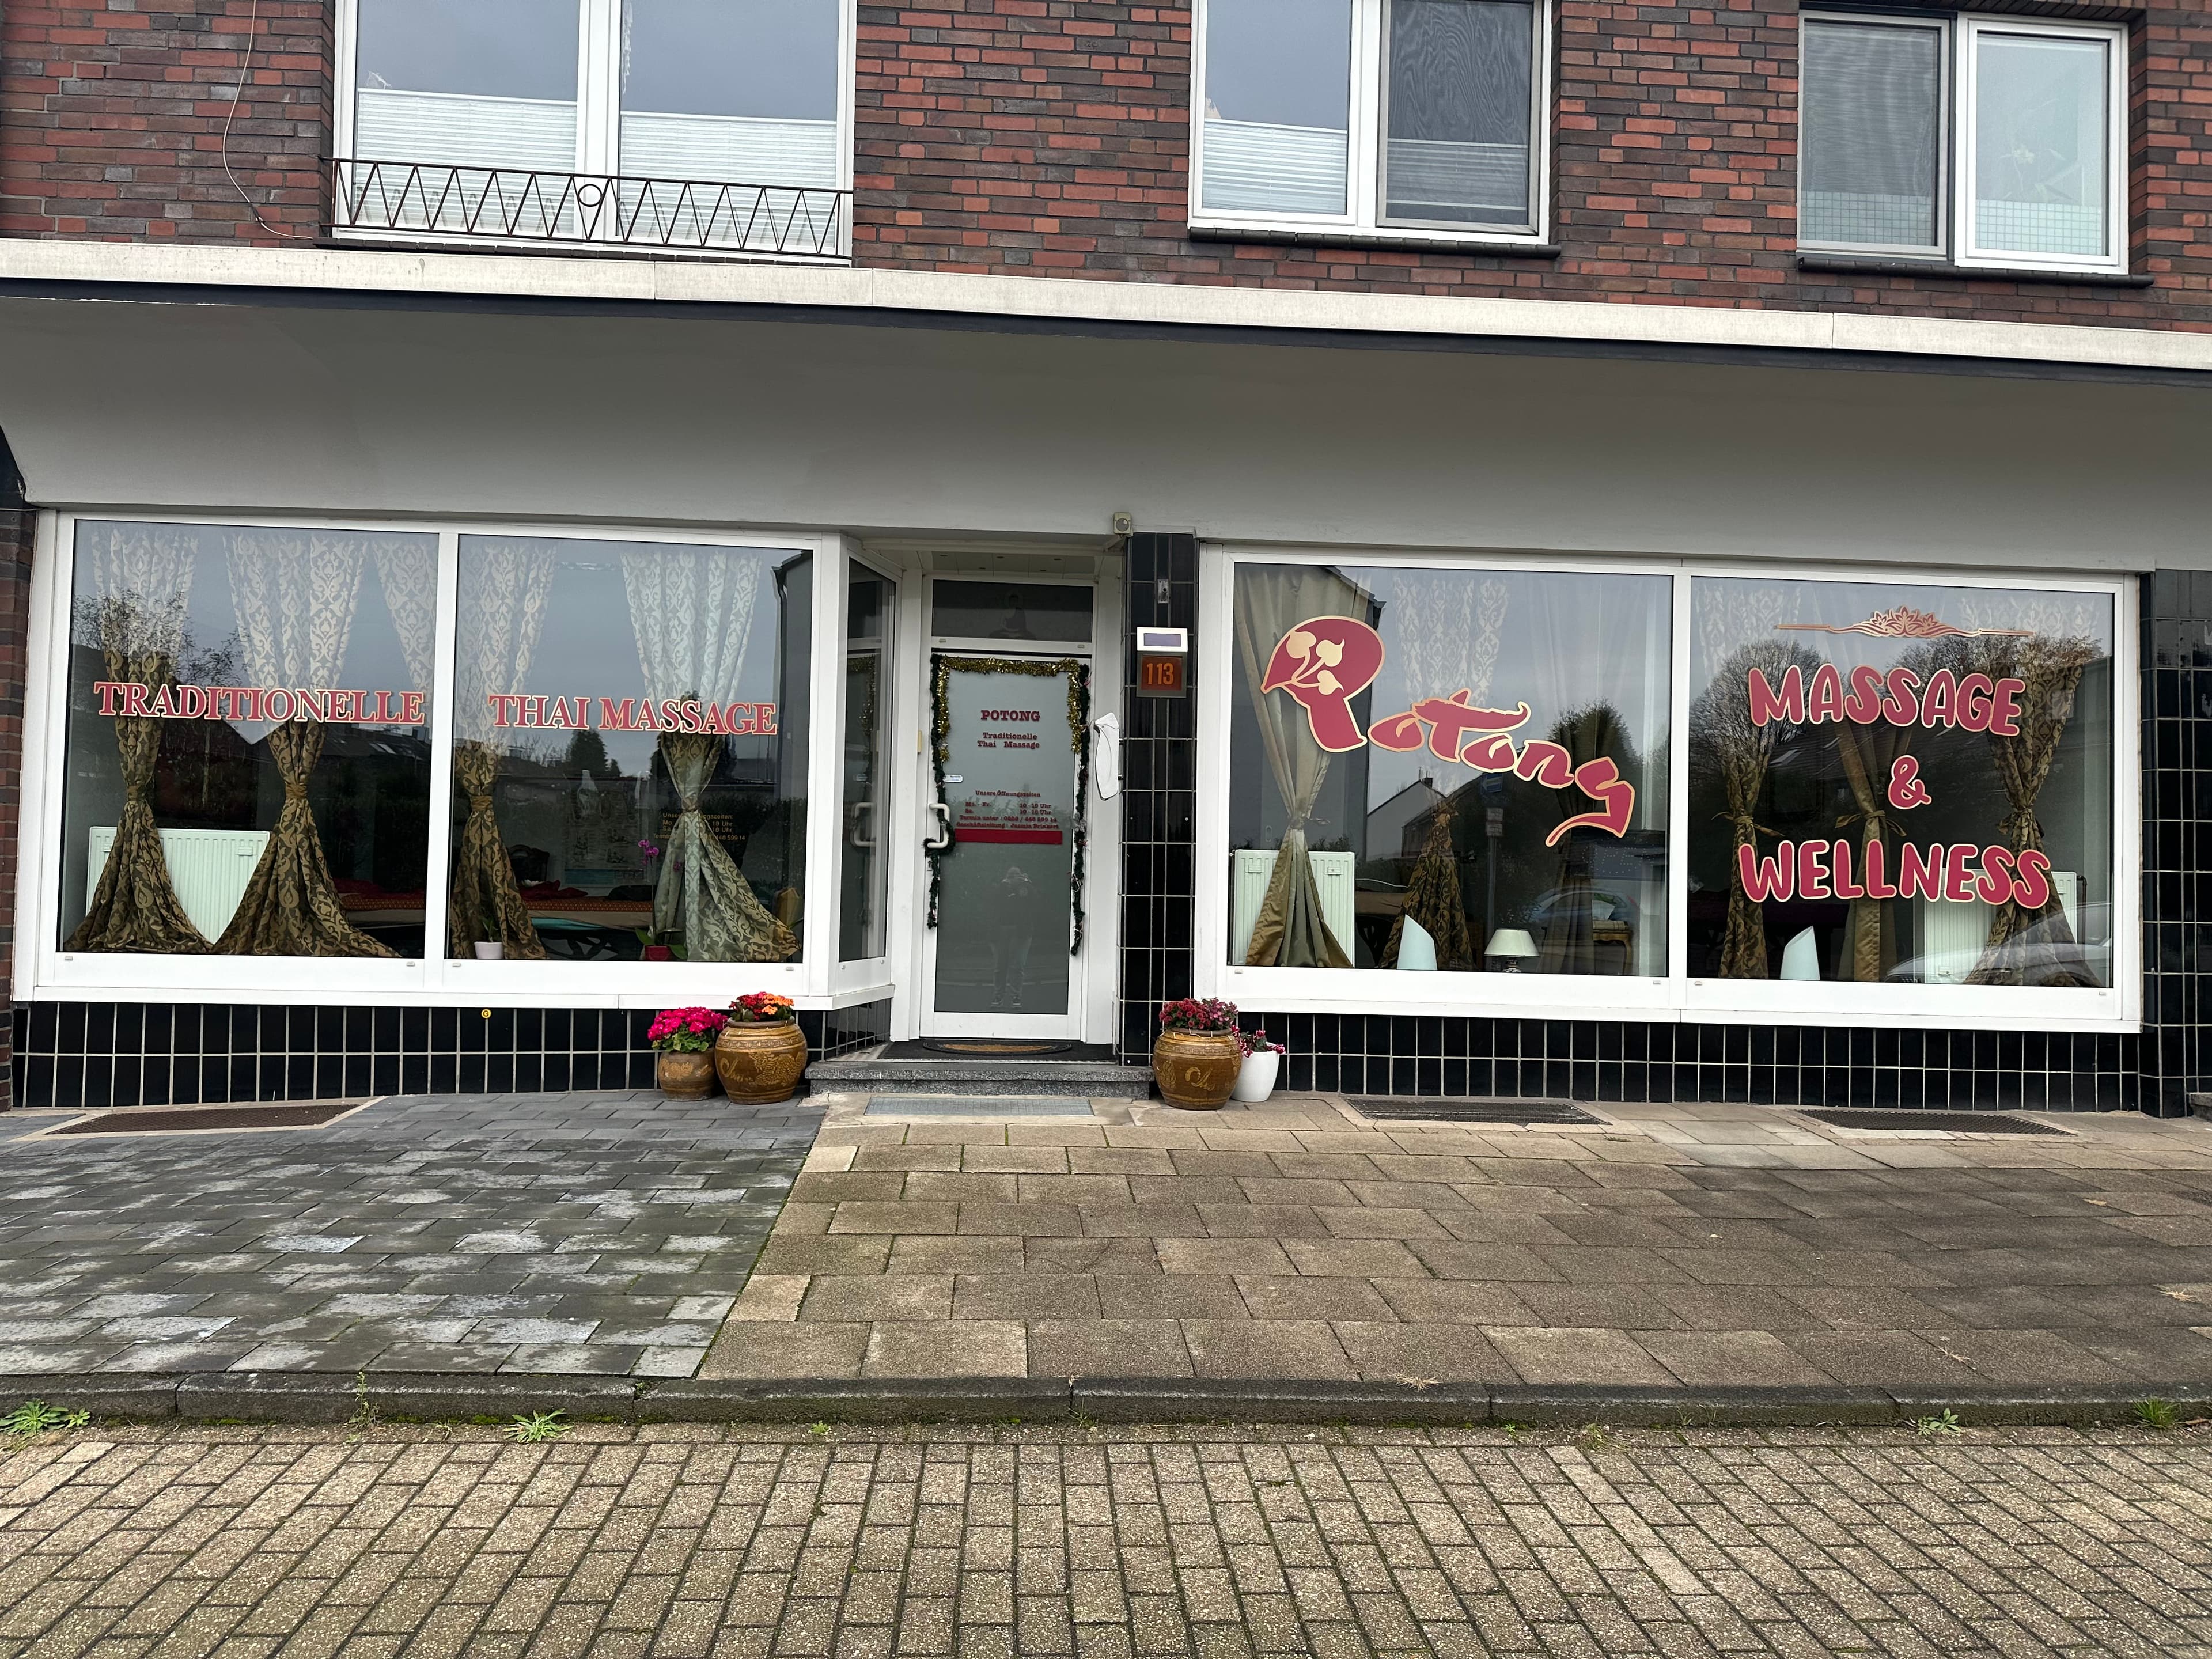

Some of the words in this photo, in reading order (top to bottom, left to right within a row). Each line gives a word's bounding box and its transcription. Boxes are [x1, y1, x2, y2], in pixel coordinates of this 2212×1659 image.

[1146, 663, 1174, 685] 113
[94, 681, 425, 725] TRADITIONELLE
[488, 695, 590, 730] THAI
[598, 698, 777, 736] MASSAGE
[981, 710, 1040, 721] POTONG
[1748, 664, 2026, 737] MASSAGE
[1004, 741, 1040, 749] Massage
[1888, 755, 1932, 810] &
[1738, 839, 2051, 909] WELLNESS
